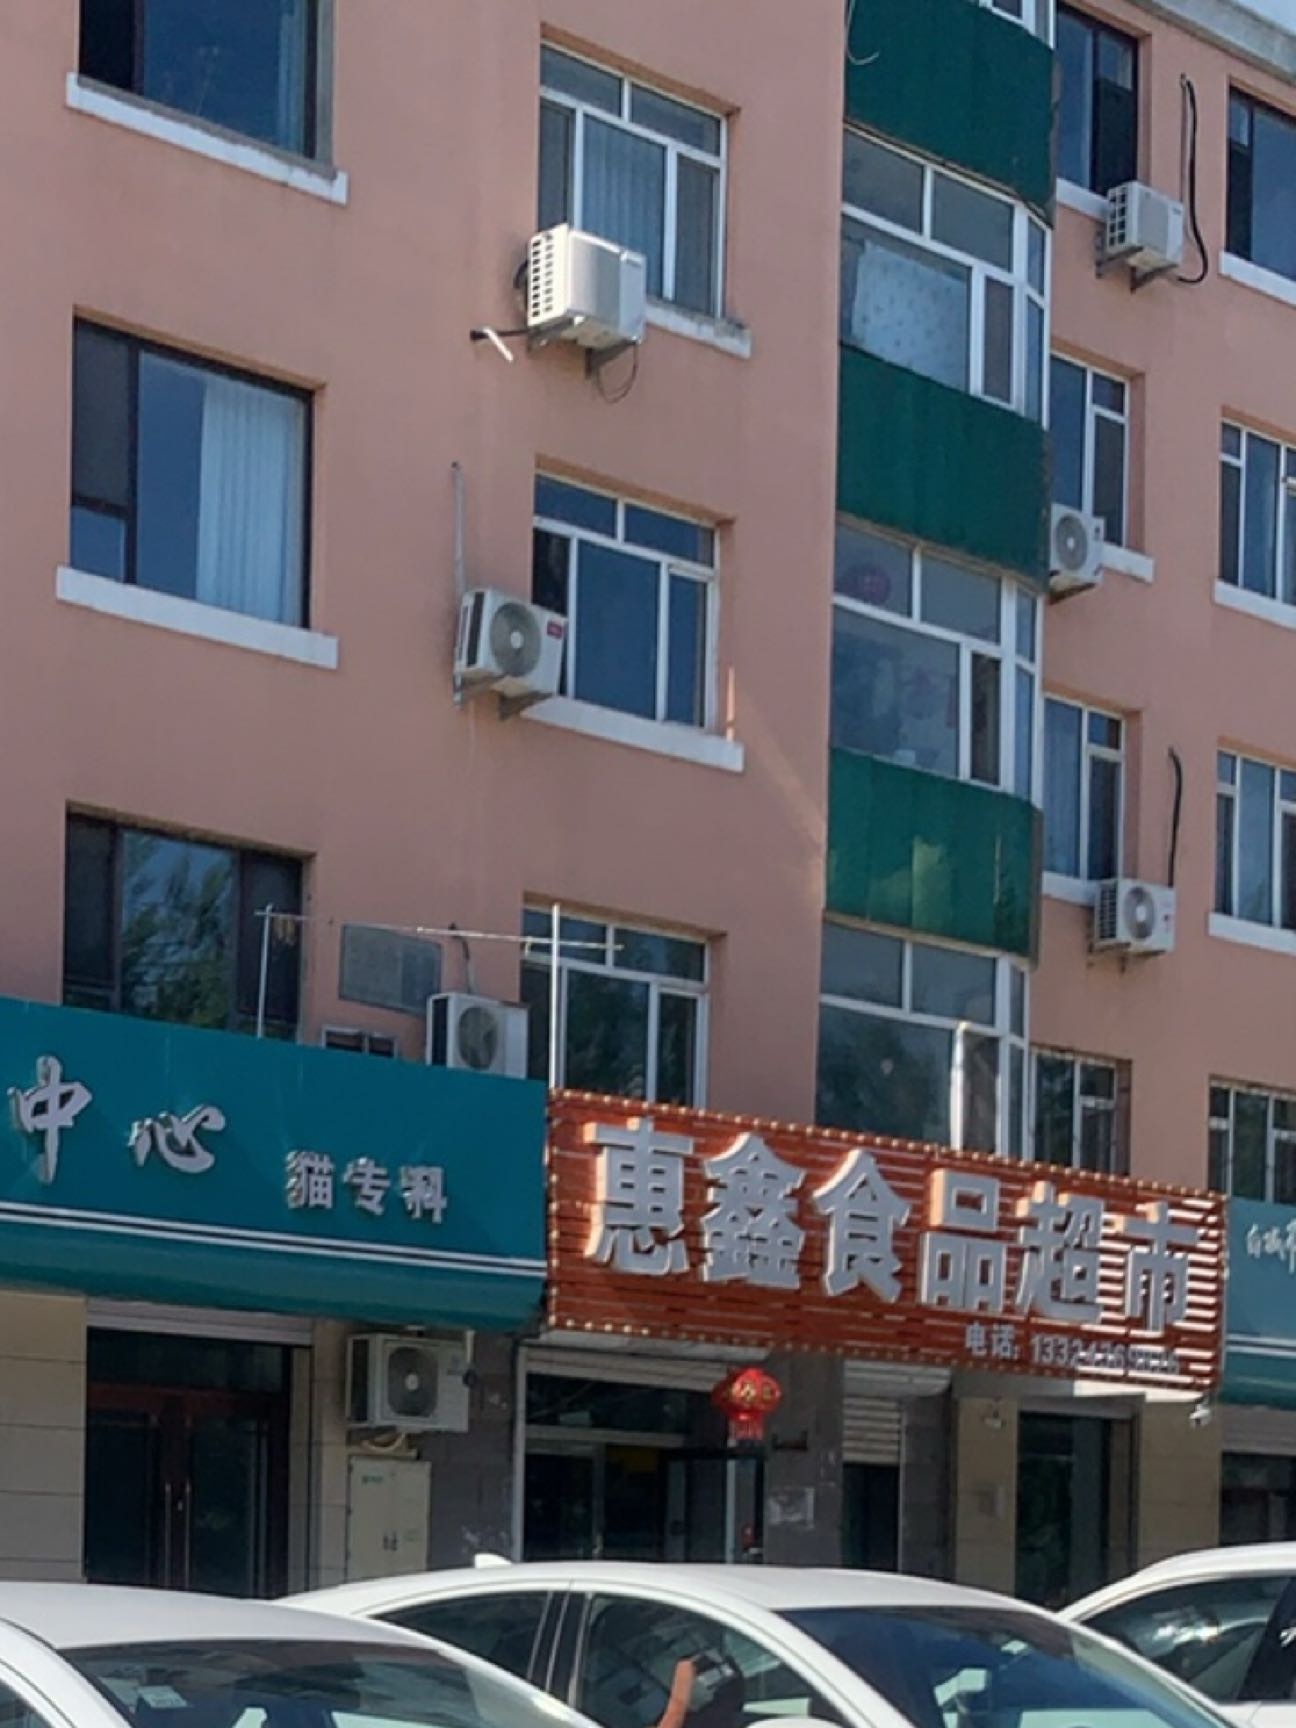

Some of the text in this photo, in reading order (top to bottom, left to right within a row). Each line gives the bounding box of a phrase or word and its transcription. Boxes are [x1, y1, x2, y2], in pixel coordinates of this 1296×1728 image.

[582, 1116, 1200, 1334] 惠鑫食品超市
